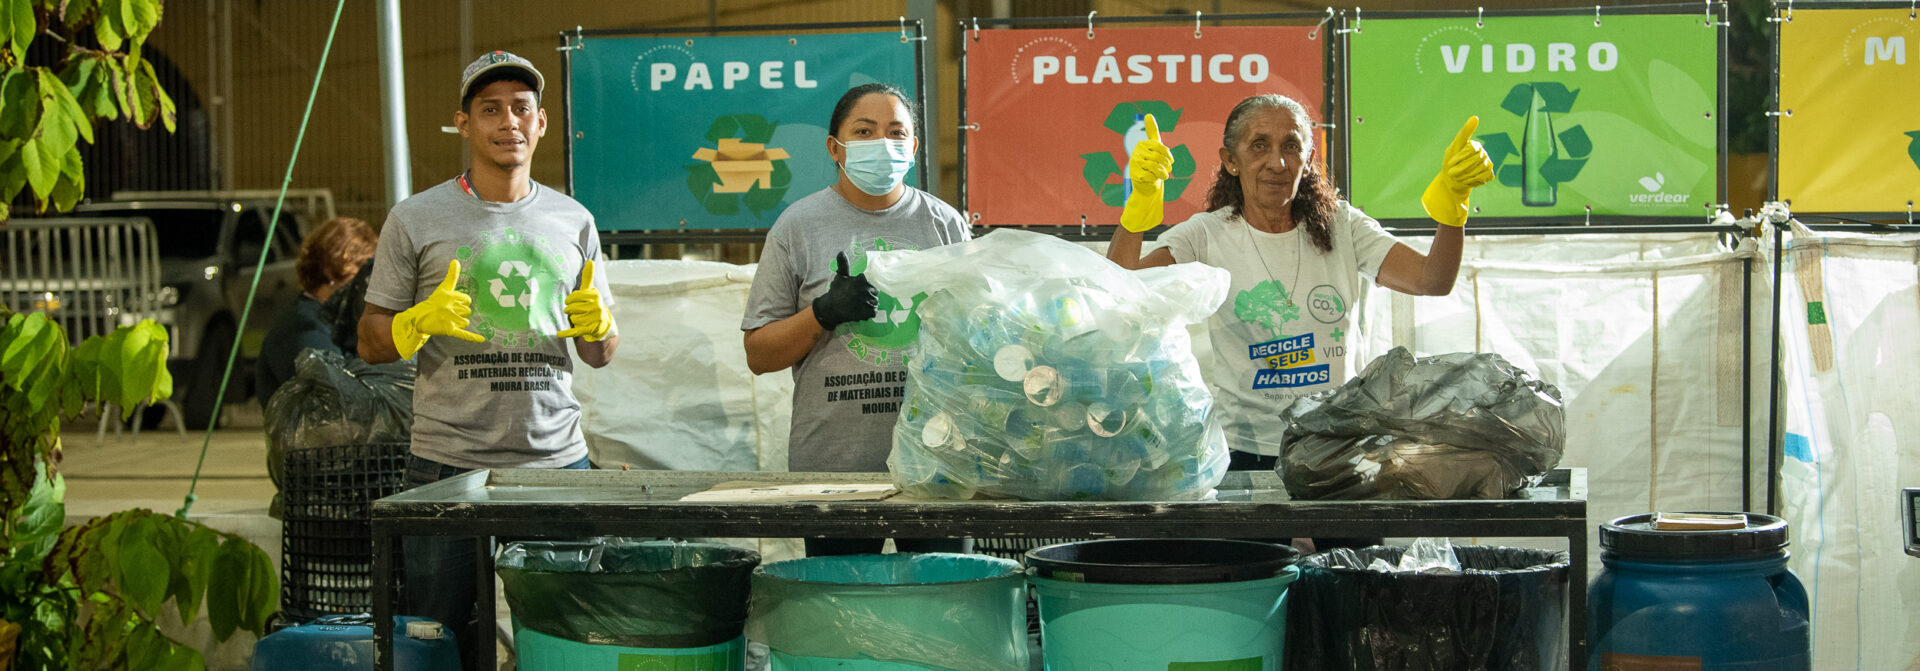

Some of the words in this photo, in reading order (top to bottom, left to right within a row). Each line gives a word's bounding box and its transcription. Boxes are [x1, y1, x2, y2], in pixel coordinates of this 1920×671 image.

[1440, 42, 1618, 73] VIDRO
[1864, 36, 1920, 66] M
[1033, 46, 1269, 84] PLÁSTICO
[650, 60, 818, 91] PAPEL
[1629, 191, 1690, 203] verdear
[1252, 336, 1311, 356] RECICLE
[454, 351, 509, 366] ASSOCIAÇÃO
[511, 352, 522, 363] DE
[1269, 349, 1310, 369] SEUS
[458, 369, 468, 380] DE
[470, 368, 517, 379] MATERIAIS
[824, 371, 882, 387] ASSOCIAÇÃO
[885, 371, 897, 383] DE
[490, 382, 522, 392] MOURA
[524, 381, 550, 391] BRASIL
[827, 391, 838, 402] DE
[839, 387, 891, 401] MATERIAIS
[862, 402, 897, 414] MOURA
